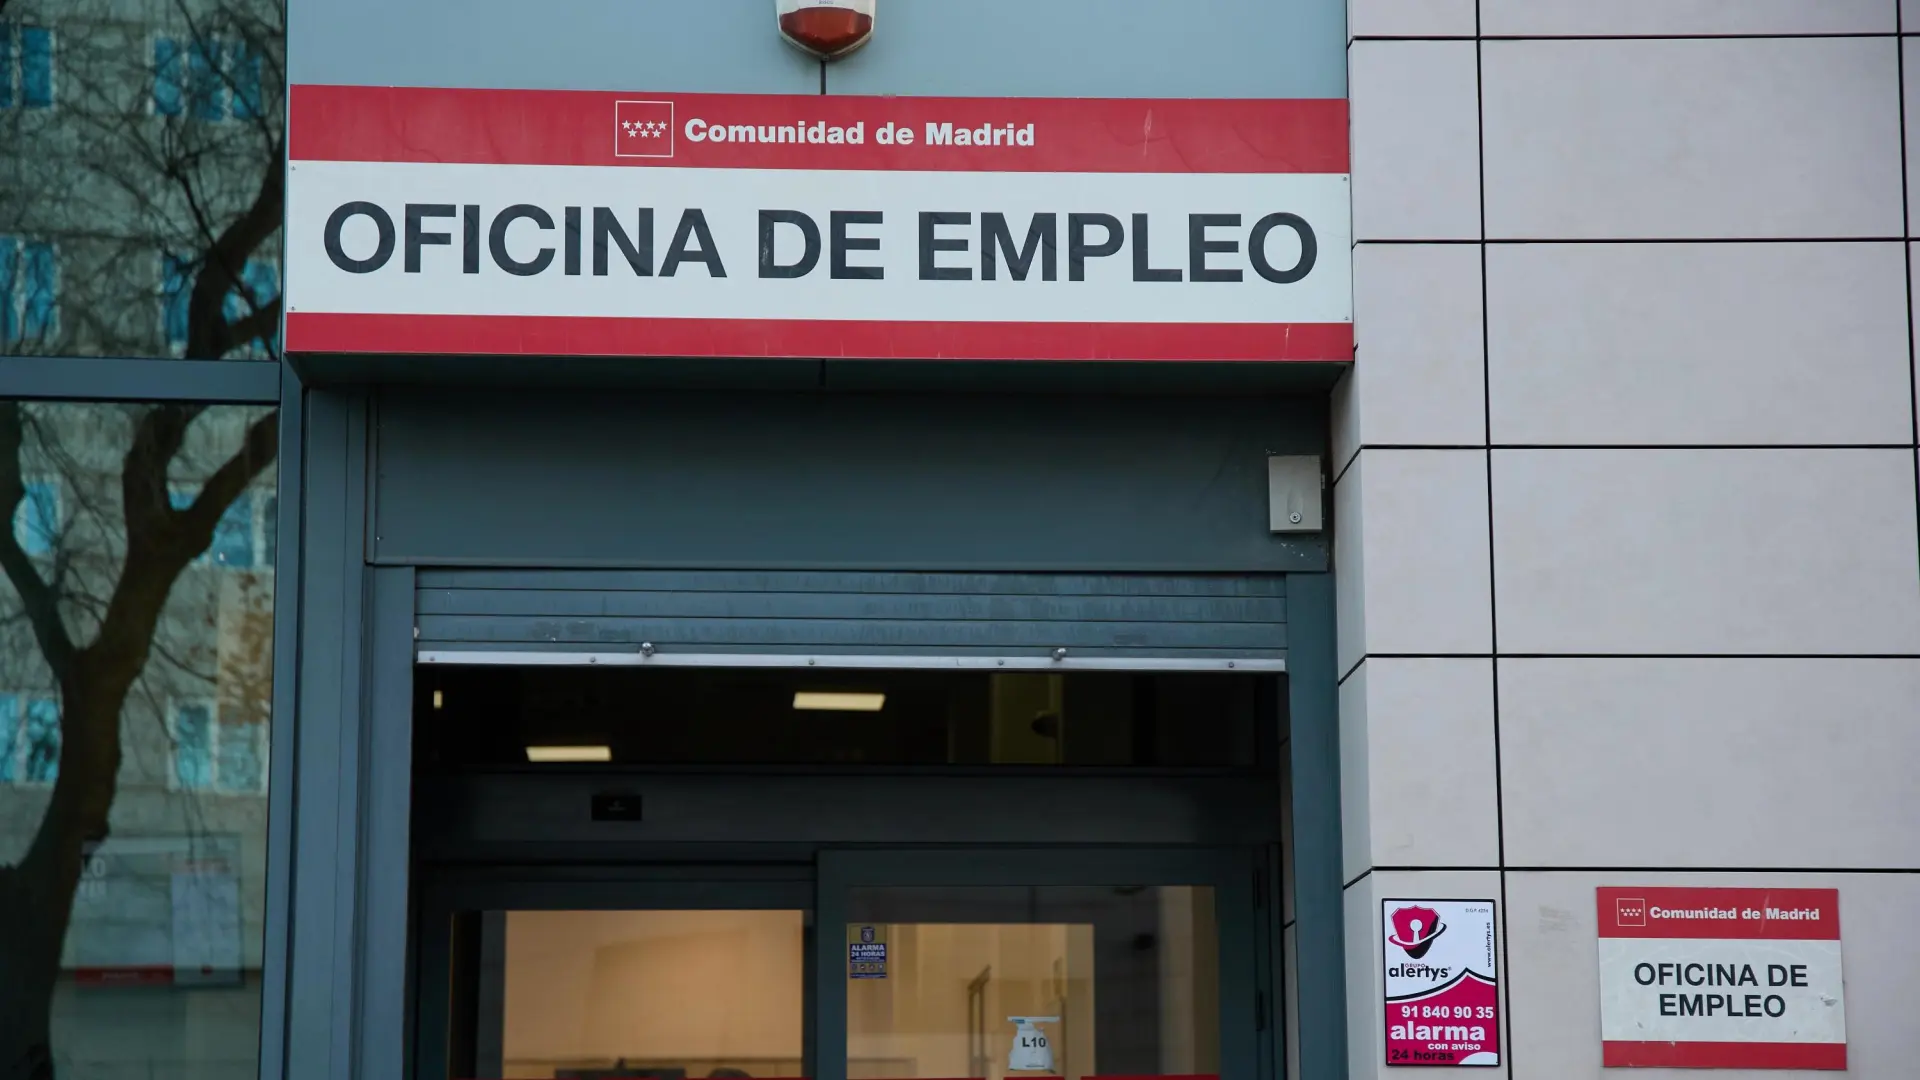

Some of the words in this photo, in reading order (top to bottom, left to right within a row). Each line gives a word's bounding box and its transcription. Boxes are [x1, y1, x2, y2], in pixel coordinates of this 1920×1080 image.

[684, 118, 864, 146] Comunidad
[875, 121, 914, 146] de
[925, 122, 1035, 147] Madrid
[323, 200, 728, 278] OFICINA
[758, 209, 885, 280] DE
[918, 211, 1318, 284] EMPLEO
[1650, 906, 1737, 920] Comunidad
[1741, 907, 1761, 920] de
[1766, 907, 1820, 921] Madrid
[1634, 962, 1759, 987] OFICINA
[1767, 964, 1809, 987] DE
[1401, 1005, 1419, 1018] 91
[1422, 1006, 1450, 1018] 840
[1453, 1006, 1472, 1018] 90
[1475, 1006, 1494, 1019] 35
[1659, 993, 1786, 1018] EMPLEO
[1390, 1021, 1486, 1041] alarma
[1022, 1037, 1046, 1048] L10
[1427, 1042, 1448, 1050] con
[1451, 1041, 1481, 1051] aviso
[1391, 1049, 1409, 1060] 24
[1413, 1049, 1455, 1061] horas
